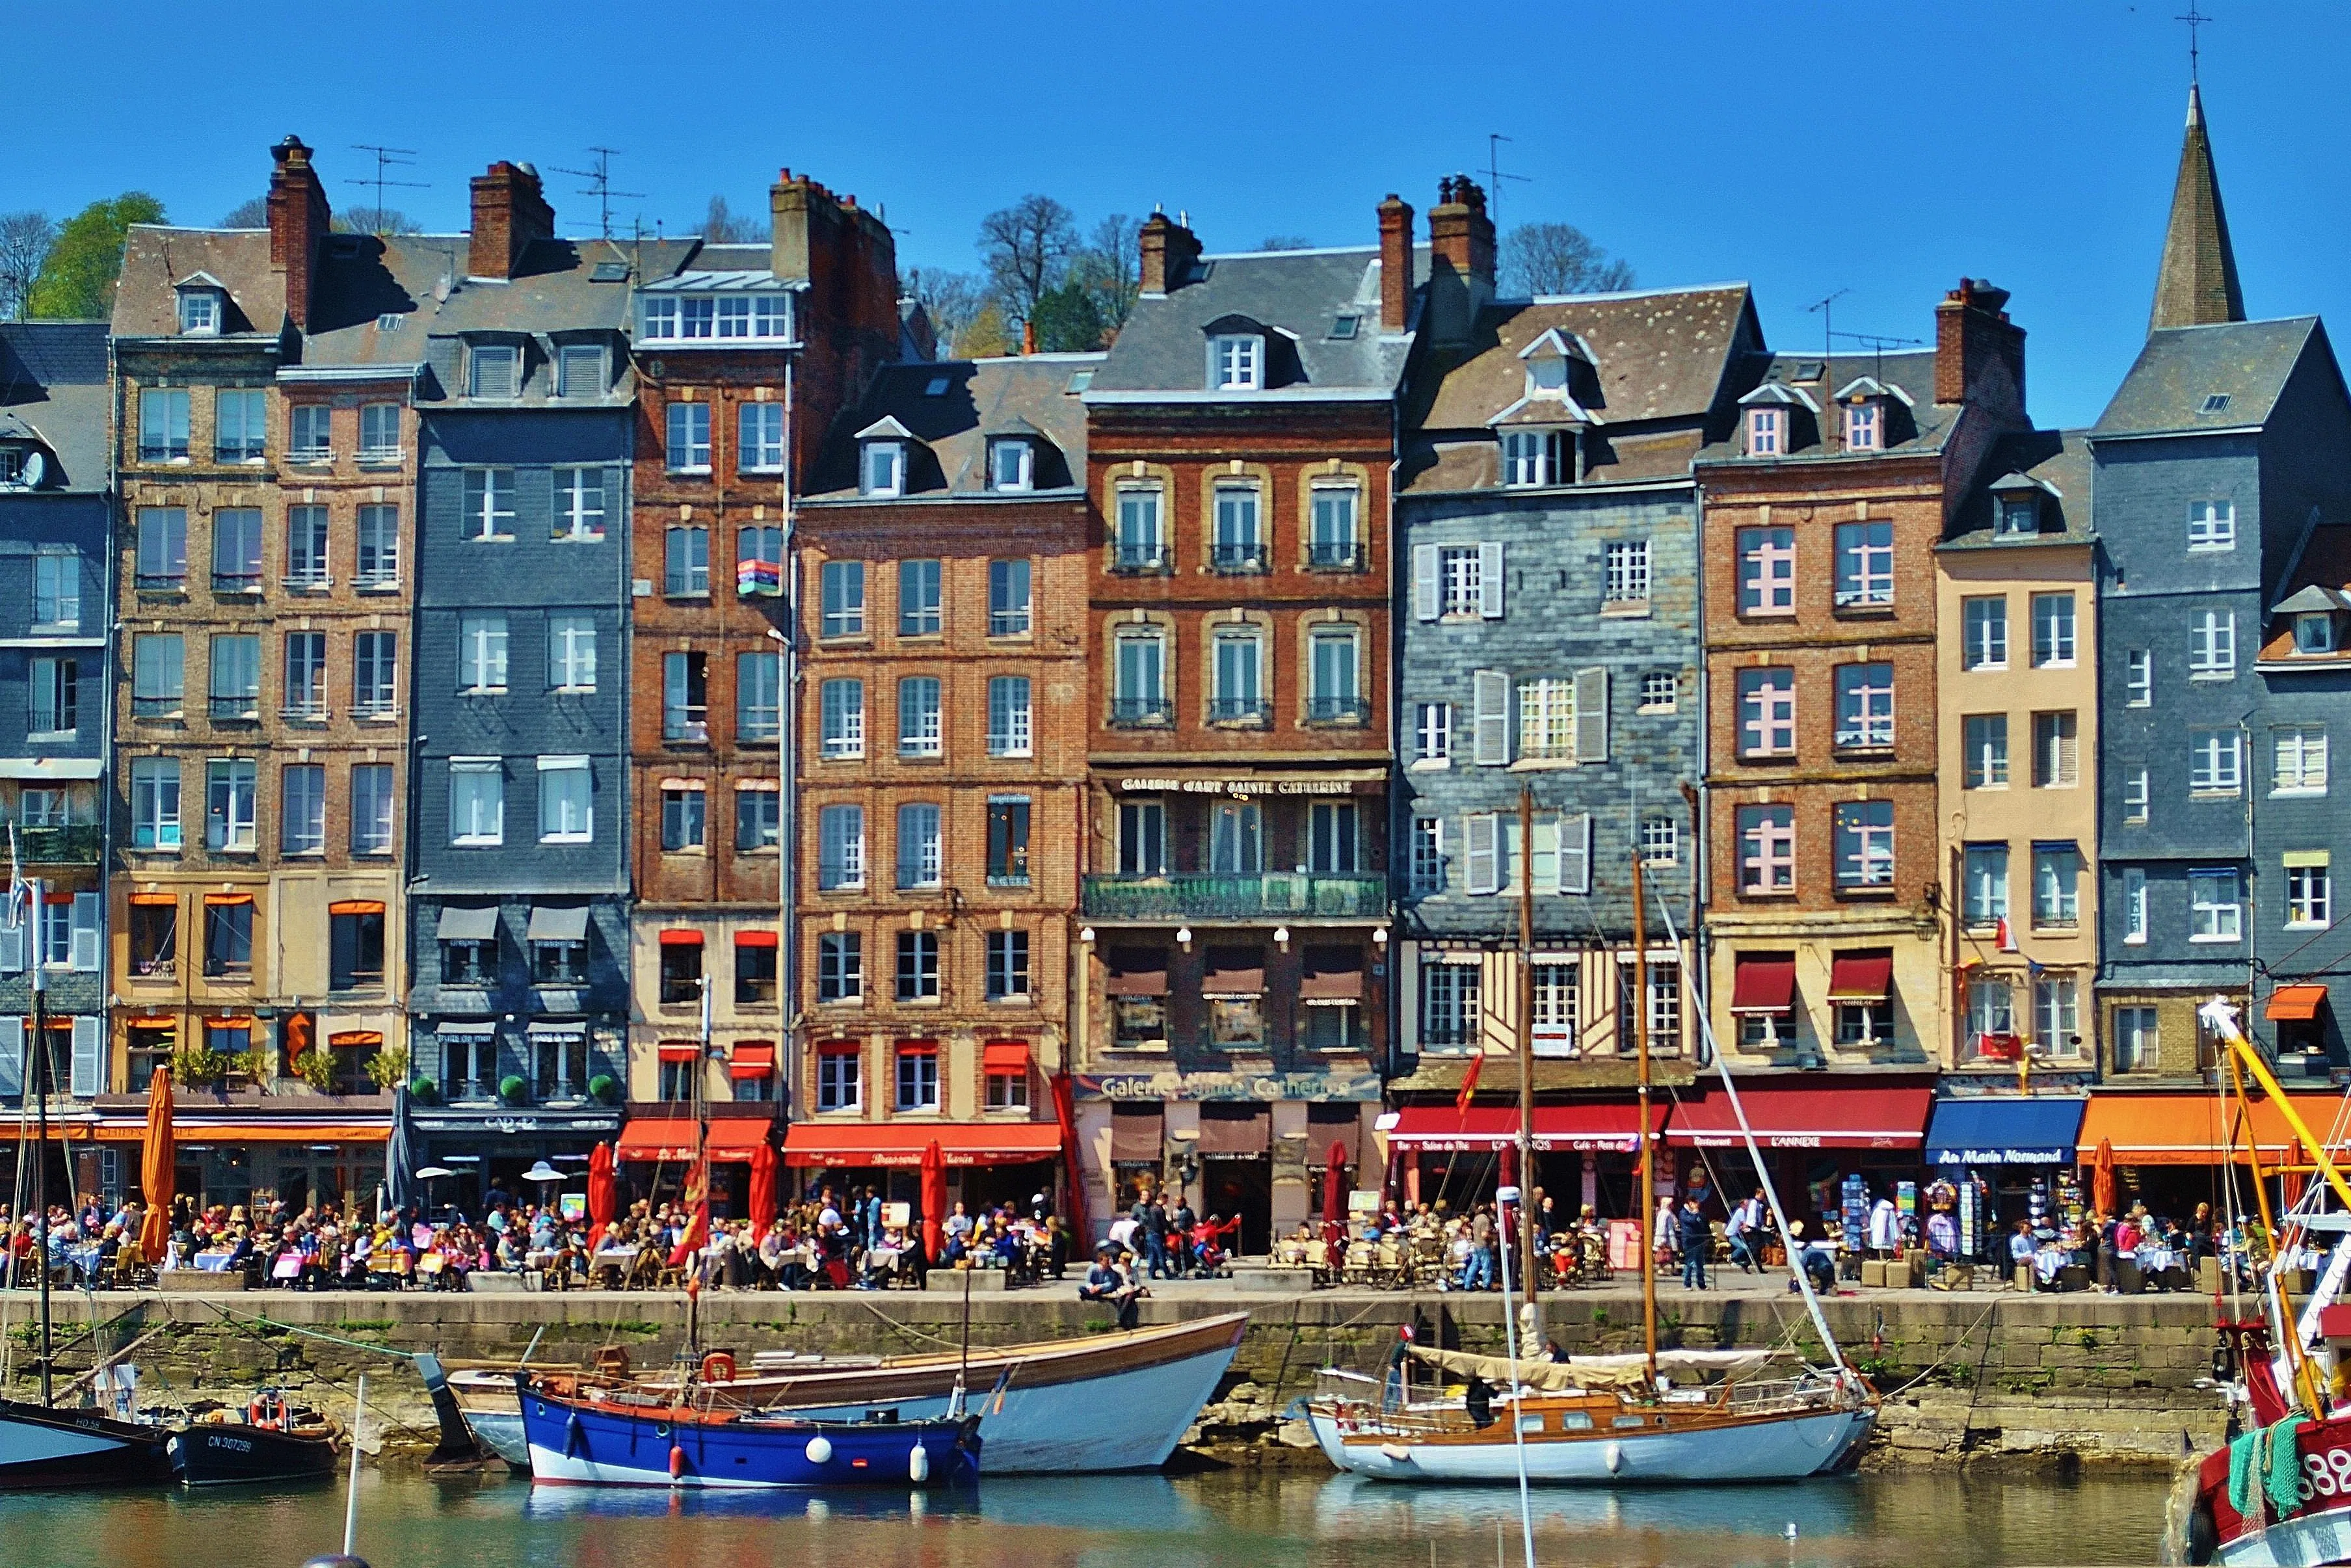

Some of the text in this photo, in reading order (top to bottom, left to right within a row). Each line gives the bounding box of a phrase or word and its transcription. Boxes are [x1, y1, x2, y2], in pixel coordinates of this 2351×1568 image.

[1102, 1076, 1173, 1098] Galerie
[1771, 1137, 1820, 1147] L'ANNEXE
[1961, 1150, 2002, 1163] Marin
[2004, 1149, 2061, 1163] Normand
[208, 1436, 221, 1446] CN
